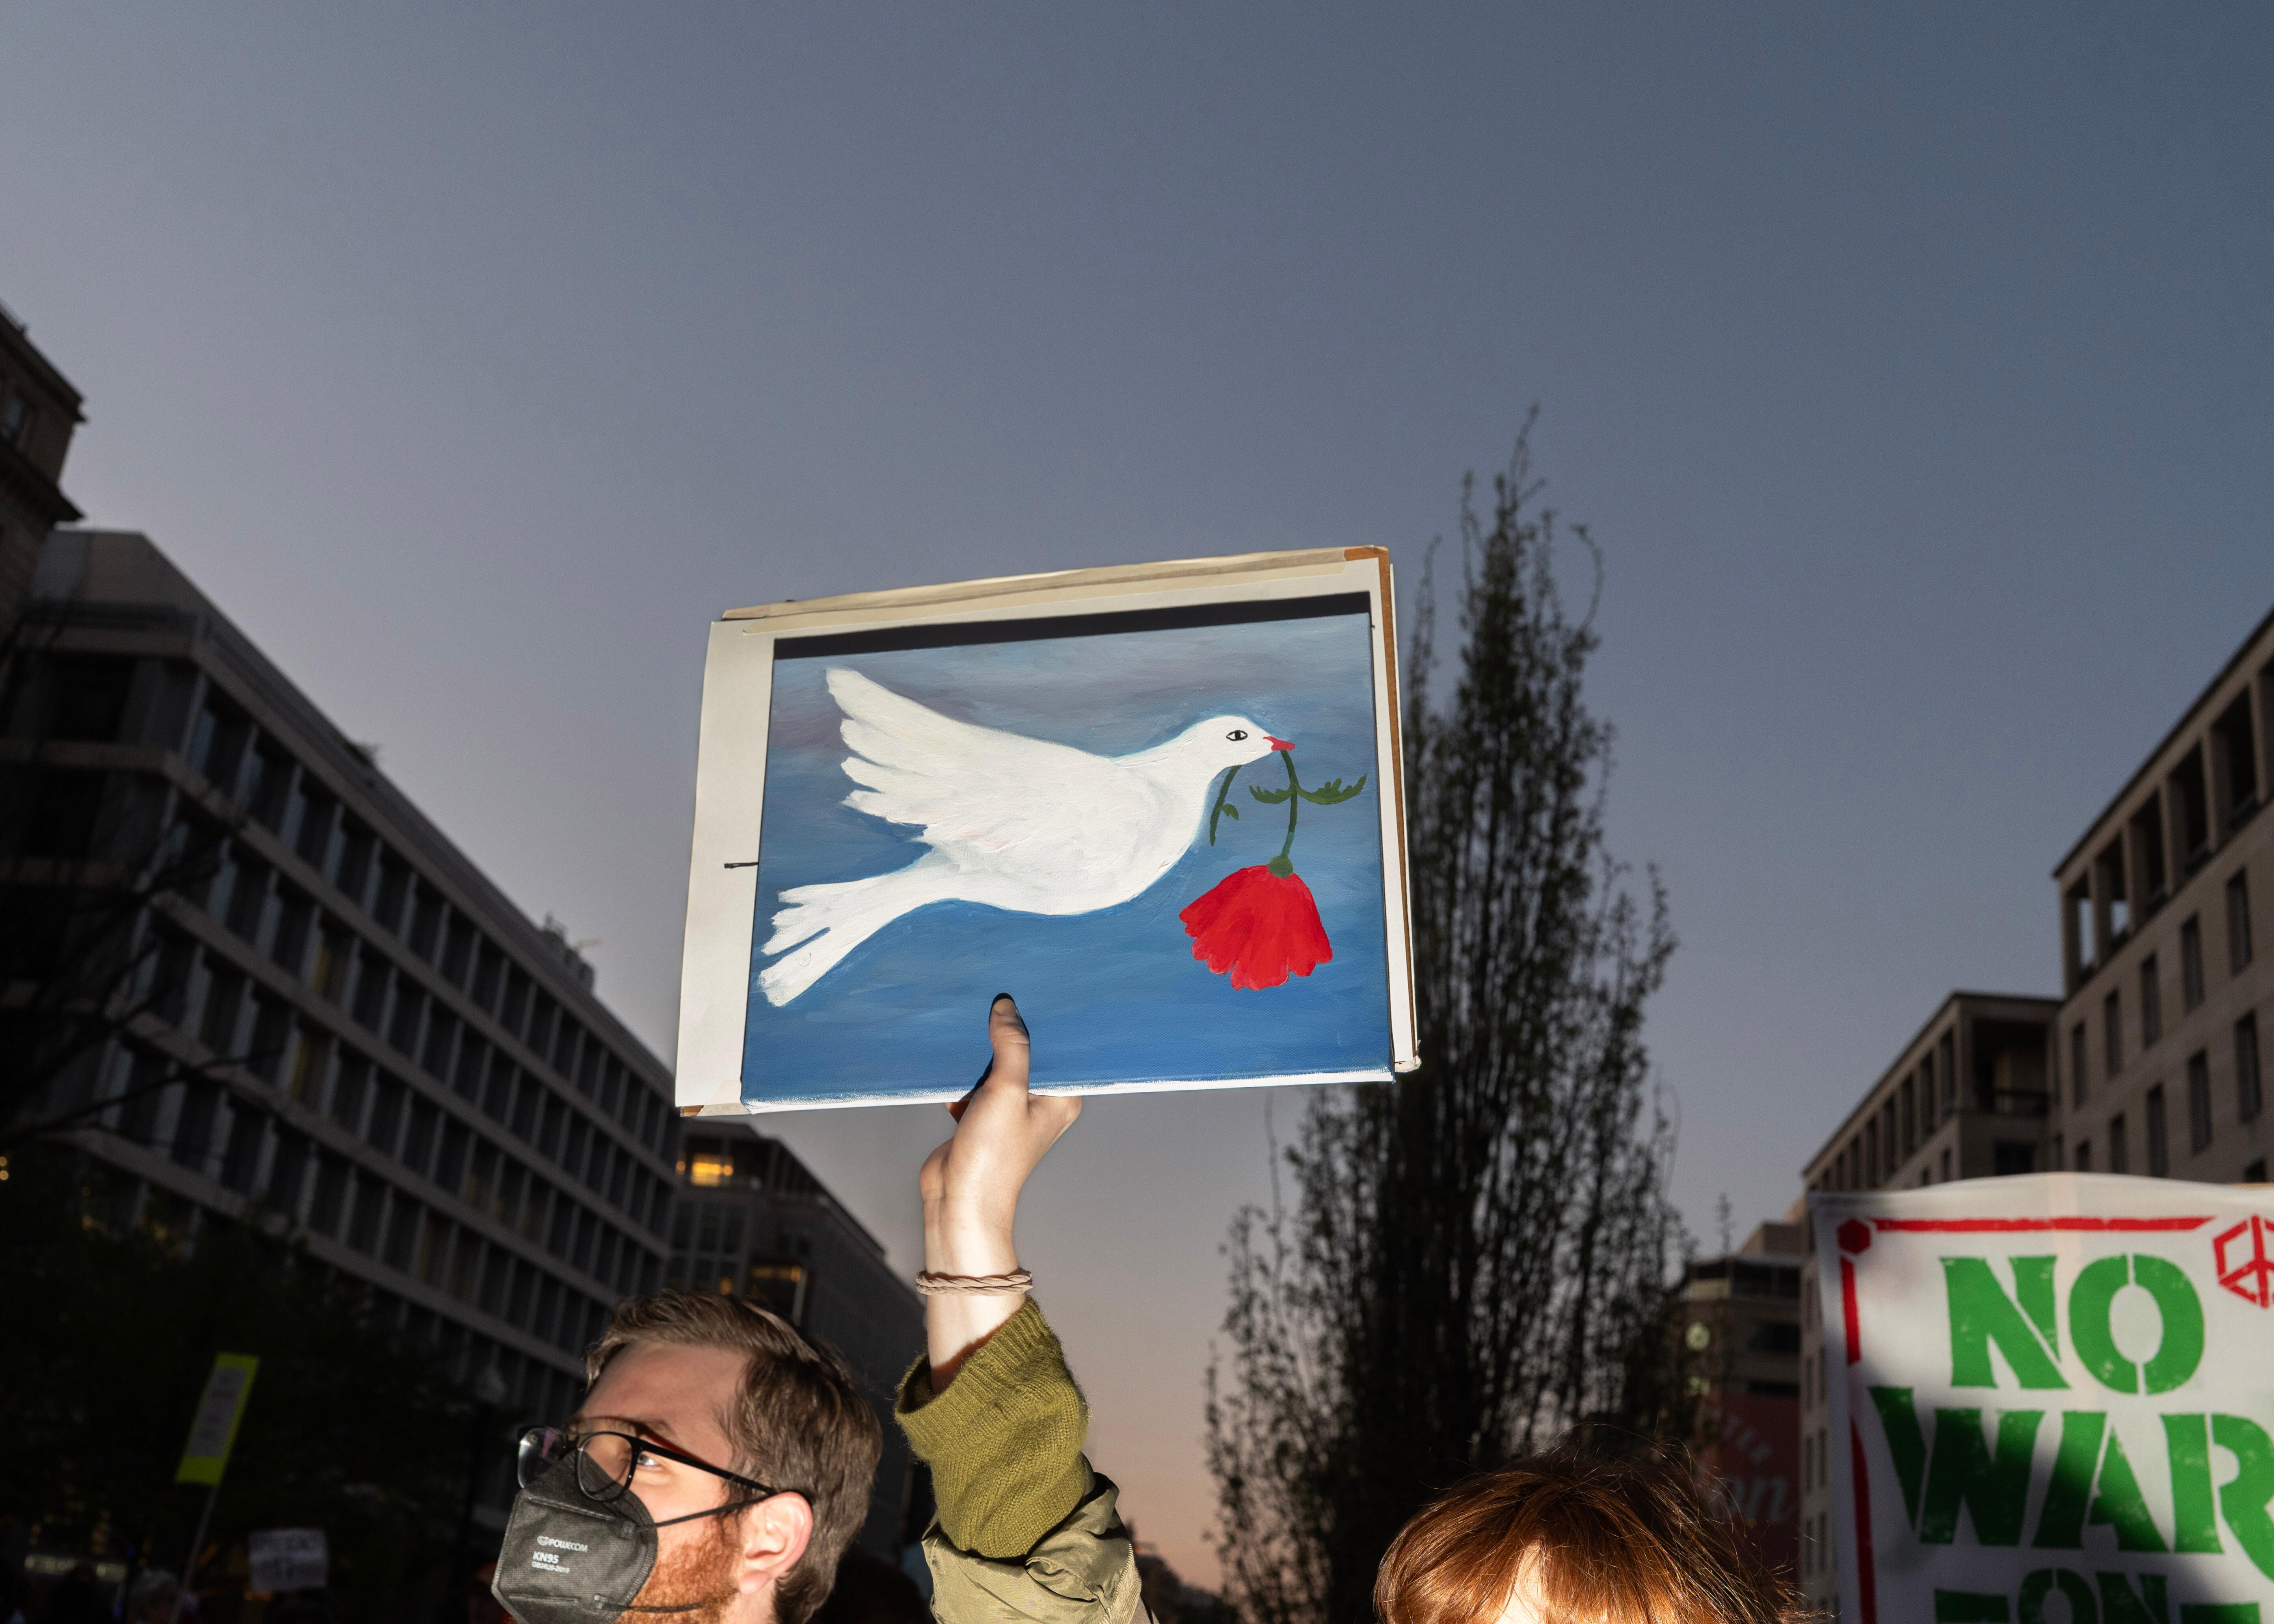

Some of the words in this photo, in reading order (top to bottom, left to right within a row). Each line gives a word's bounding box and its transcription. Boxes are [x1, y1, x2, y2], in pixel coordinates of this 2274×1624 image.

[1939, 1253, 2204, 1395] NO
[1868, 1386, 2274, 1582] WAR
[533, 1551, 559, 1564] KN95
